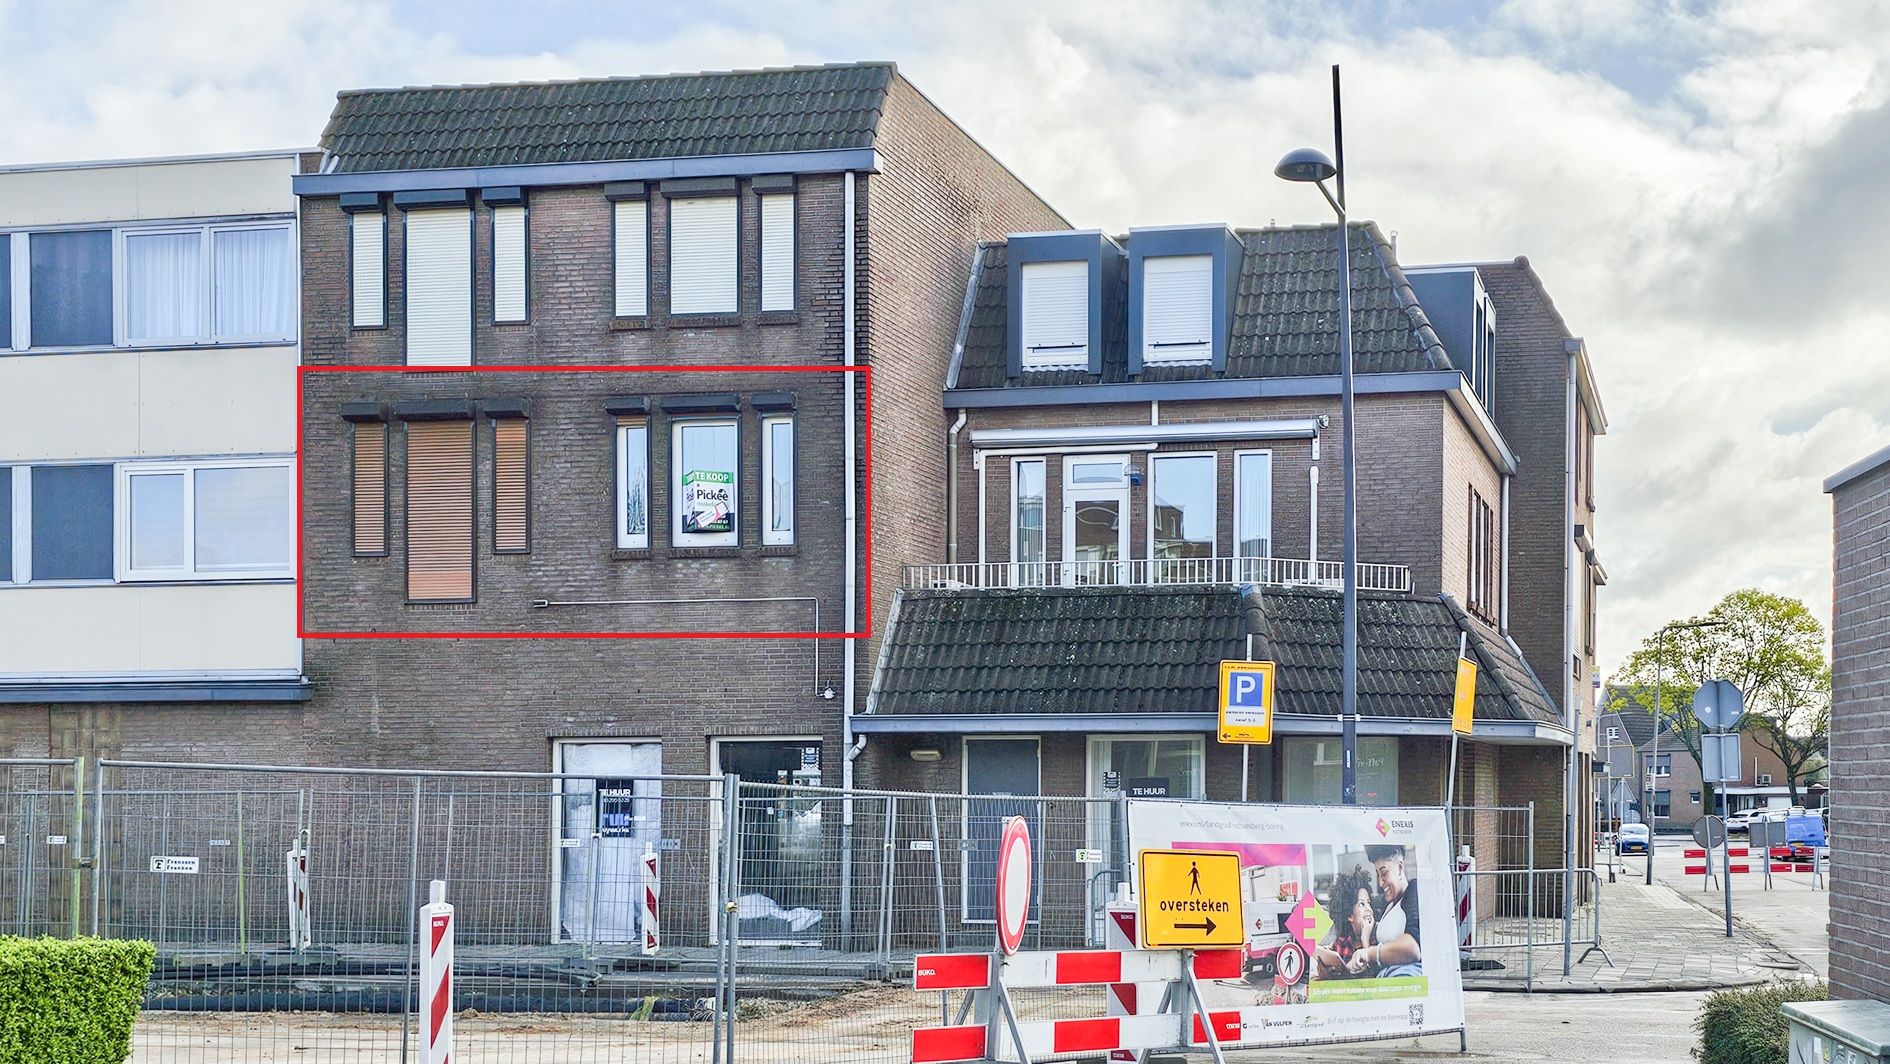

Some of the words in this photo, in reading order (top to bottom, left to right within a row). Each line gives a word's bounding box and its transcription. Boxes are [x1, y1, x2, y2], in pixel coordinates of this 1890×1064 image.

[695, 472, 705, 480] TE
[706, 472, 729, 481] KOOP
[696, 489, 729, 501] Pickee
[1236, 675, 1256, 704] P
[610, 788, 631, 796] HUUR
[1132, 787, 1142, 795] TE
[1143, 787, 1166, 795] HUUR
[1391, 820, 1414, 828] ENEXIS
[1160, 898, 1229, 912] oversteken
[1312, 988, 1331, 996] Straks
